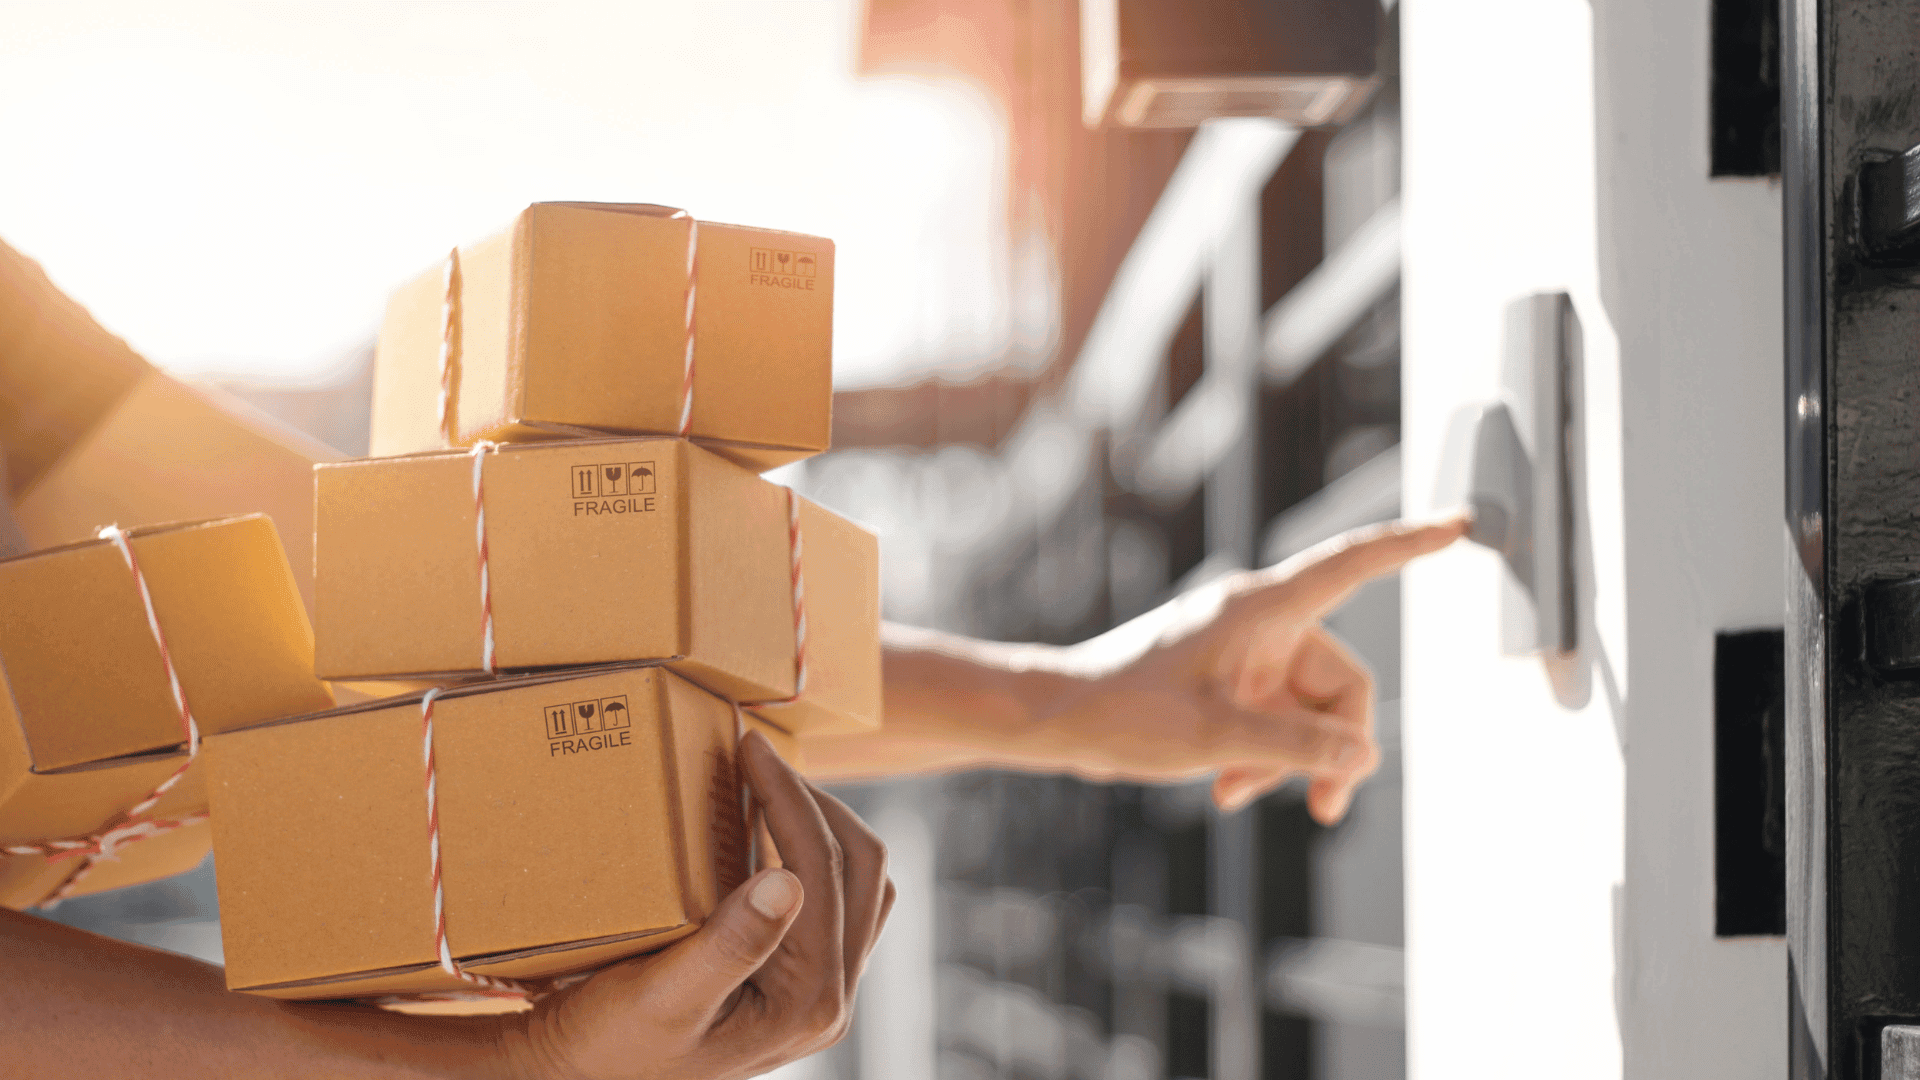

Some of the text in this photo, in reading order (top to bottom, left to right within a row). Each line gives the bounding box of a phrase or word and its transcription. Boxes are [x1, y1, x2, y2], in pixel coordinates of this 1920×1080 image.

[750, 274, 815, 291] FRAGILE
[574, 497, 656, 516] FRAGILE
[550, 731, 632, 757] FRAGILE
